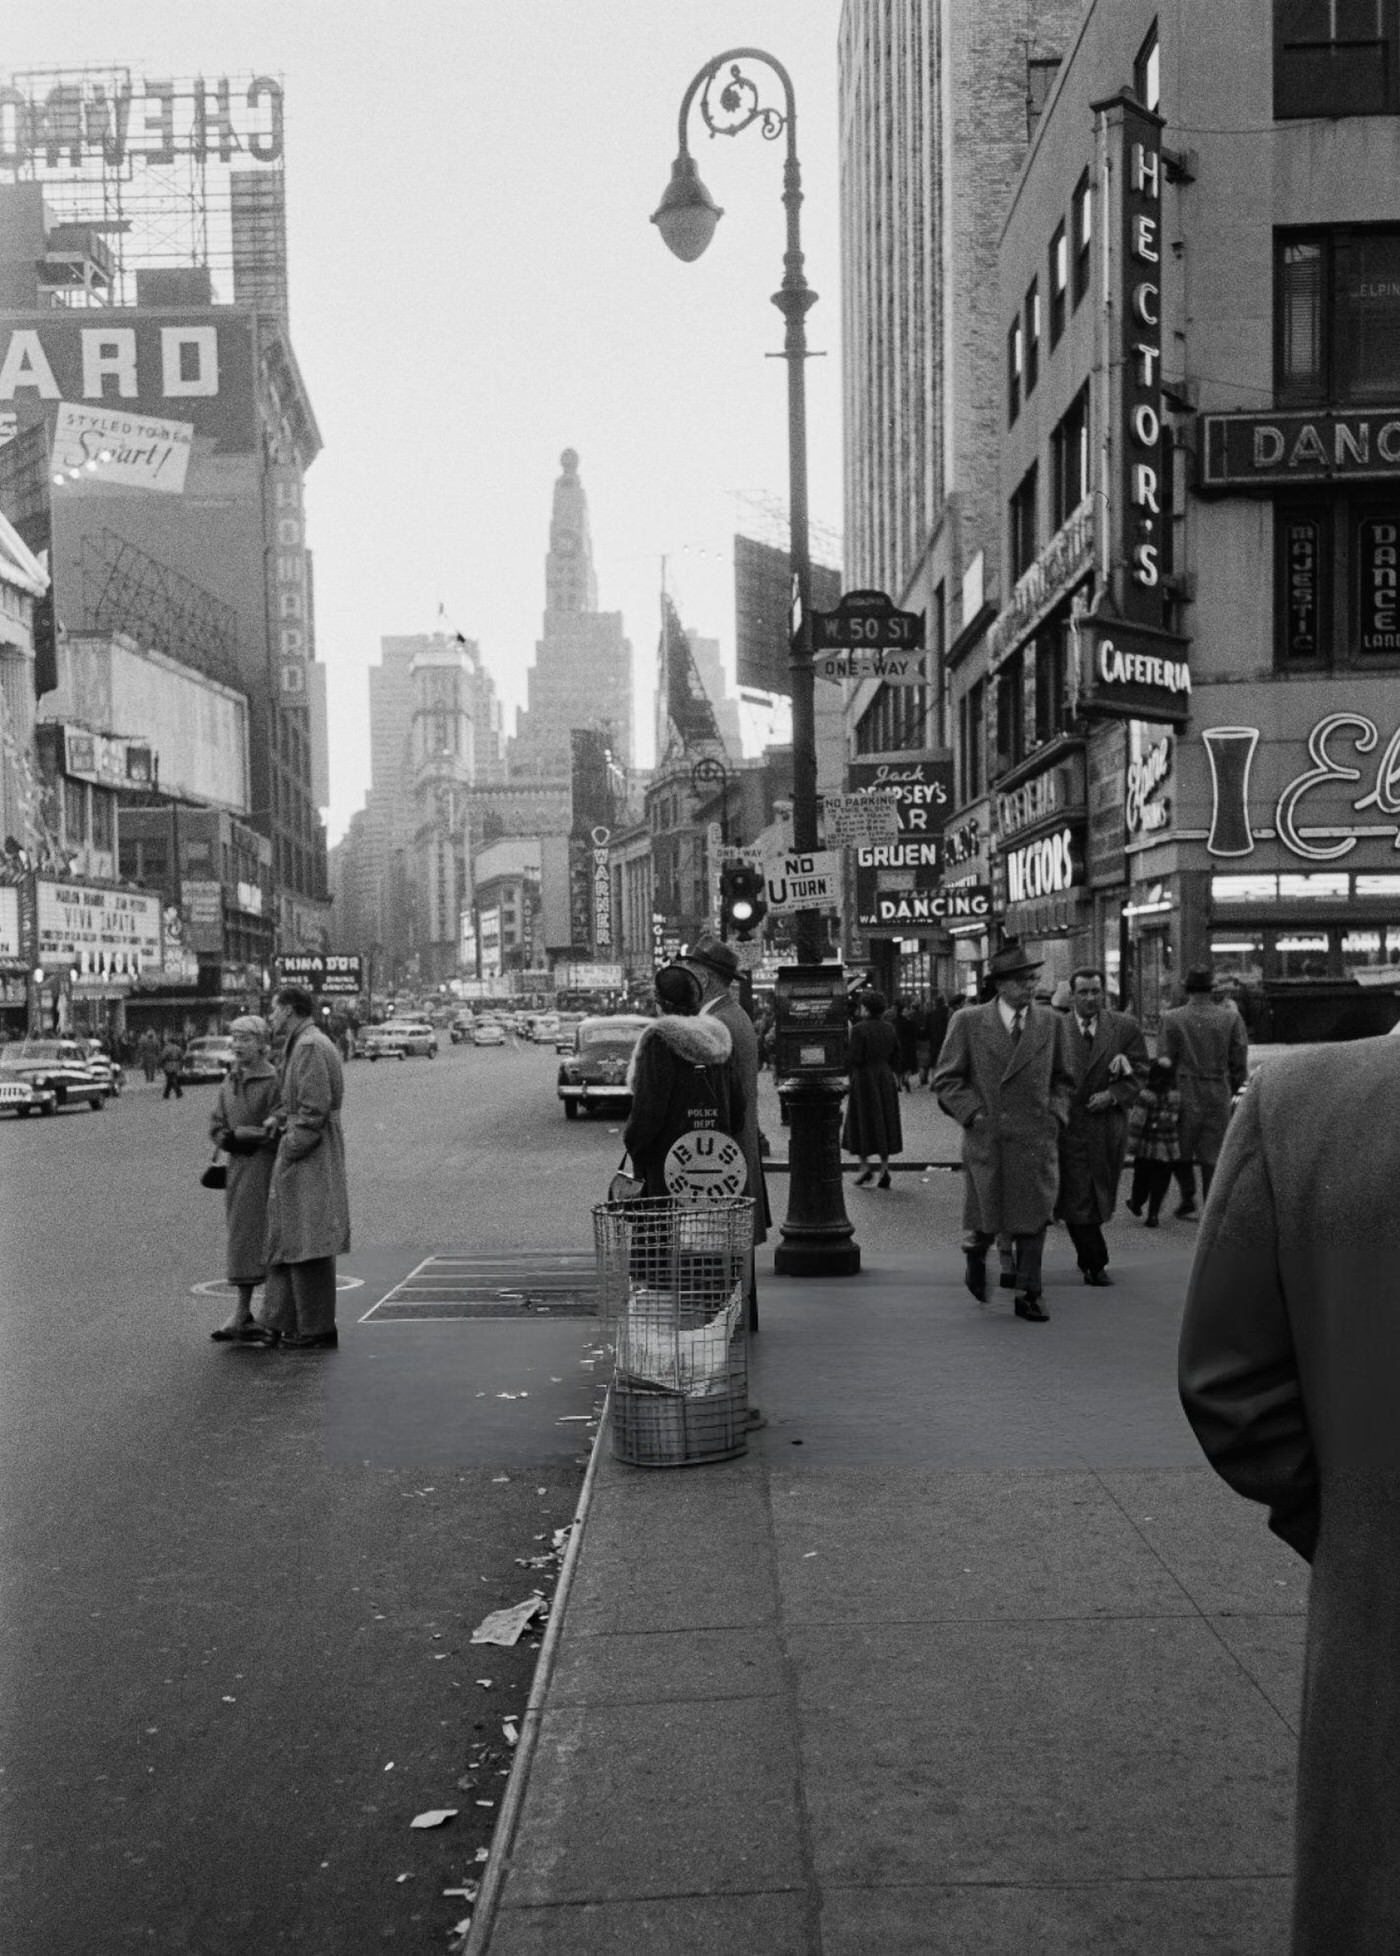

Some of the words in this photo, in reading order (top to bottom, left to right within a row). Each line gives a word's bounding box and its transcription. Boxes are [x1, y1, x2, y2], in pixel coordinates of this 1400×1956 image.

[1133, 143, 1160, 586] HECTOR'S
[67, 413, 132, 435] STYLED
[1291, 526, 1314, 650] MAJESTIC
[1371, 524, 1397, 631] DANCE
[850, 618, 879, 640] 50
[888, 618, 911, 639] ST
[824, 660, 908, 676] ONE-WAY
[1101, 639, 1192, 695] CAFETERIA
[873, 764, 926, 786] Jack
[825, 799, 841, 809] NO
[845, 797, 896, 808] PARKING
[785, 858, 814, 875] NO
[858, 843, 936, 867] GRUEN
[593, 848, 611, 945] WARNER
[768, 878, 787, 904] U
[790, 879, 826, 897] TURN
[880, 895, 989, 919] DANCING
[275, 957, 323, 971] CHINA
[322, 983, 359, 992] DANCING
[688, 1108, 718, 1118] POLICE
[694, 1120, 716, 1129] DEPT
[672, 1137, 738, 1165] BUS
[669, 1175, 739, 1203] STOP
